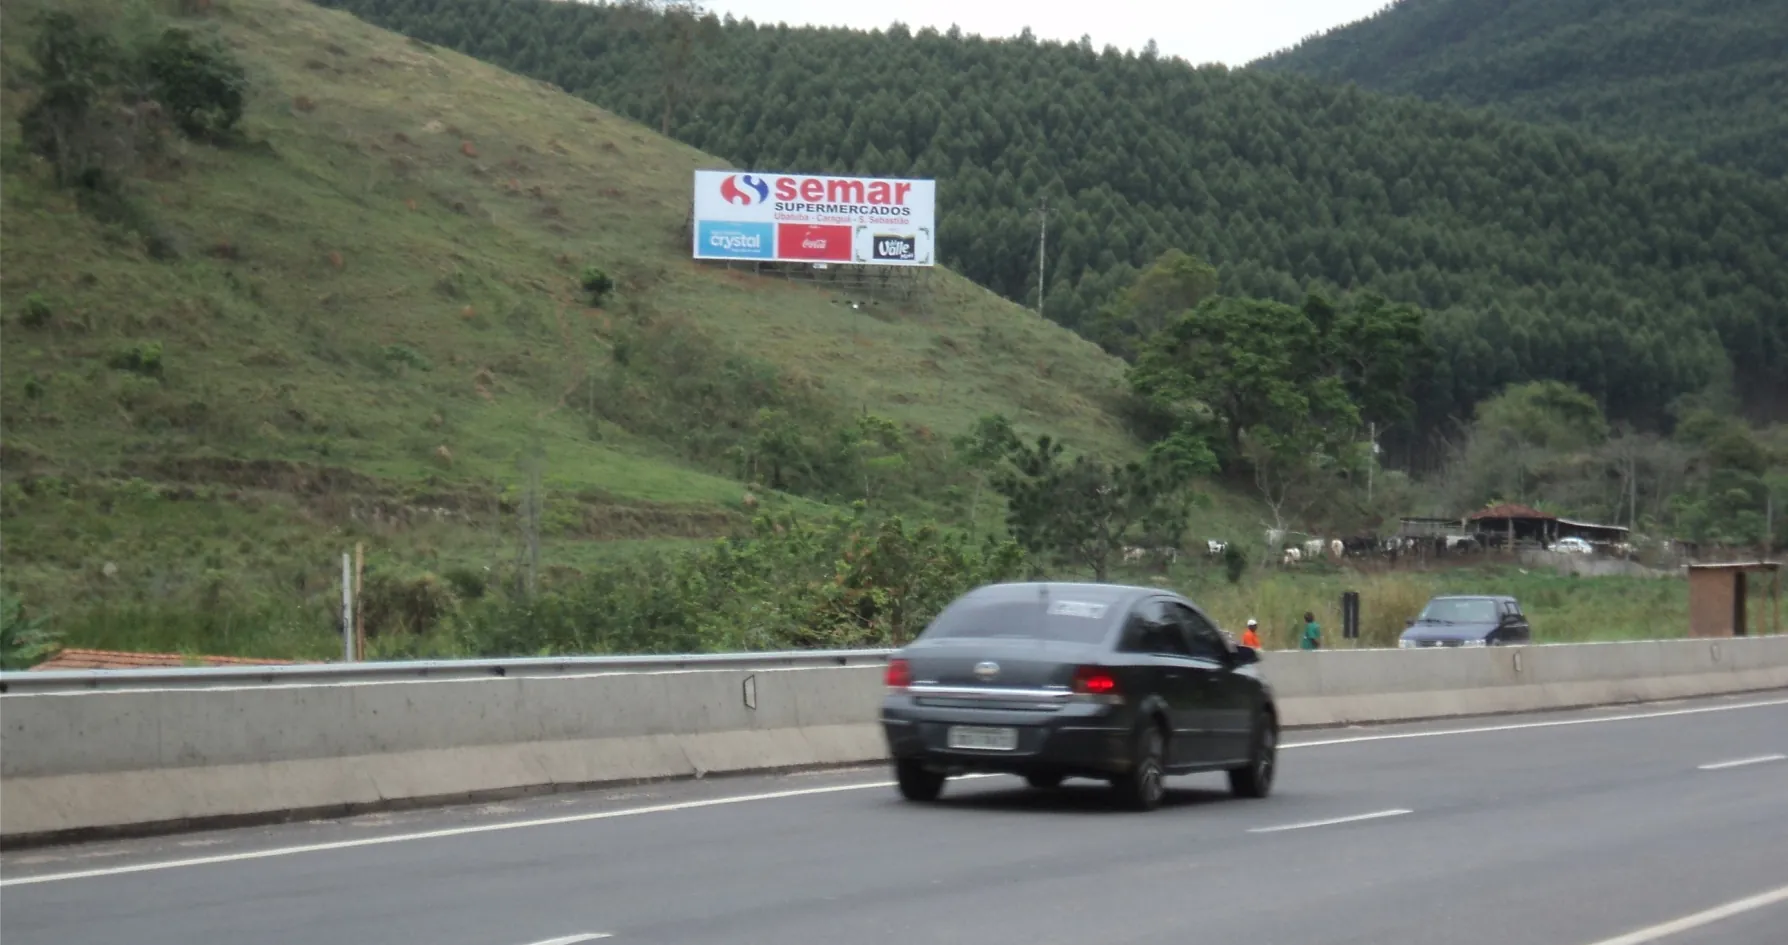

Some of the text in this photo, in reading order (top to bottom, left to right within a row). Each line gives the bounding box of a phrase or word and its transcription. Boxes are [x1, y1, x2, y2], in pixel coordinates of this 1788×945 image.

[774, 177, 911, 205] semar
[774, 202, 911, 216] SUPERMERCADOS
[710, 234, 760, 249] crystal
